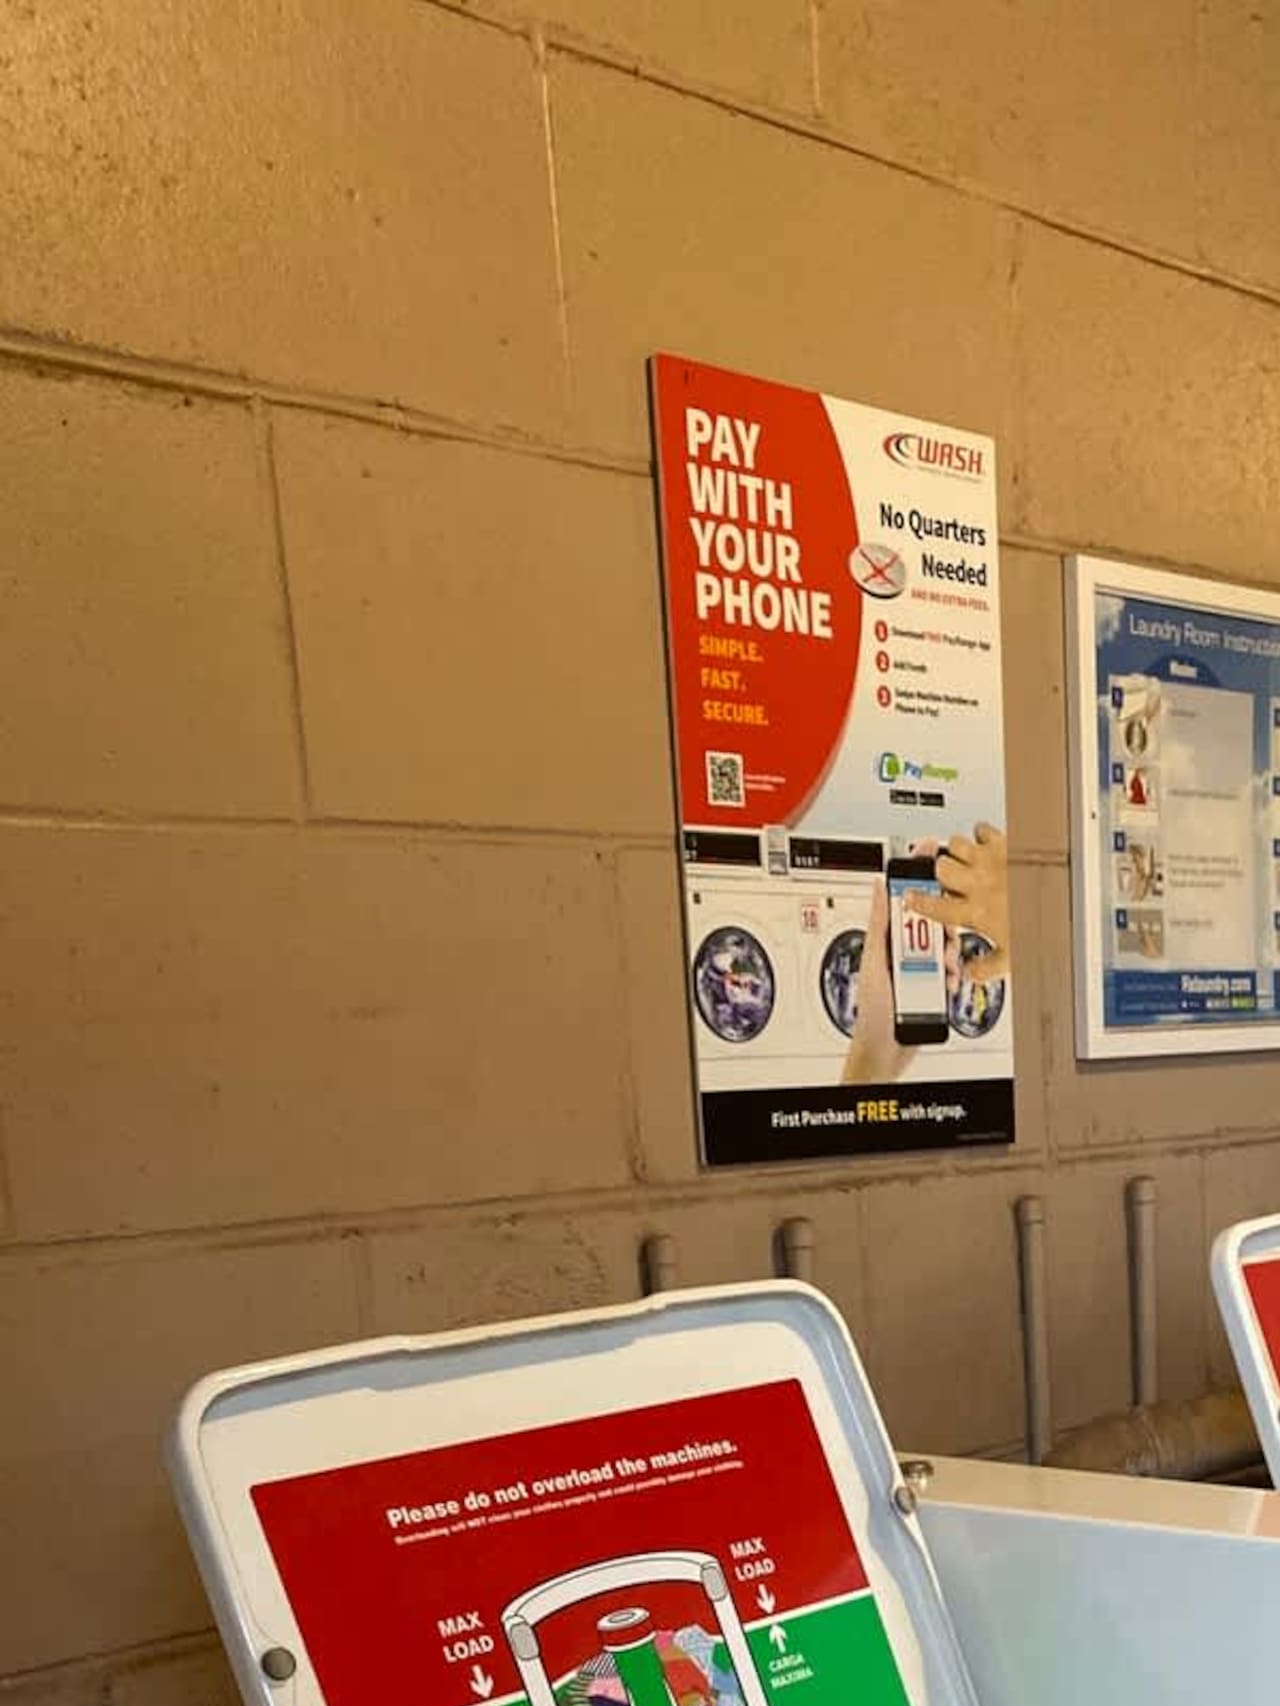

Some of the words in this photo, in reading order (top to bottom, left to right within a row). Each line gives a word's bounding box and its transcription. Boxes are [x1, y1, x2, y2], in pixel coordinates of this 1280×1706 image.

[685, 407, 761, 469] PAY
[917, 436, 985, 475] WASH
[686, 463, 793, 530] WITH
[880, 502, 905, 529] No
[908, 509, 986, 546] Quarters
[688, 517, 802, 583] YOUR
[921, 552, 987, 587] Needed
[695, 573, 832, 639] PHONE
[1129, 613, 1181, 647] Laundry
[1184, 622, 1220, 648] Room
[699, 635, 764, 662] SIMPLE.
[701, 668, 747, 692] FAST.
[703, 699, 769, 726] SECURE.
[904, 918, 930, 951] 10
[770, 1111, 800, 1127] First
[801, 1108, 855, 1127] Purchase
[856, 1100, 899, 1122] FREE
[900, 1104, 926, 1121] with
[386, 1500, 460, 1528] Please
[464, 1491, 491, 1511] do
[494, 1481, 528, 1504] not
[532, 1461, 614, 1495] overload
[615, 1457, 648, 1477] the
[650, 1440, 738, 1469] machines.
[467, 1515, 488, 1528] NOT
[729, 1537, 767, 1559] MAX
[734, 1559, 776, 1582] LOAD
[437, 1611, 484, 1638] MAX
[443, 1636, 494, 1664] LOAD
[768, 1654, 805, 1673] CARGA
[770, 1667, 814, 1689] MAXIMA
